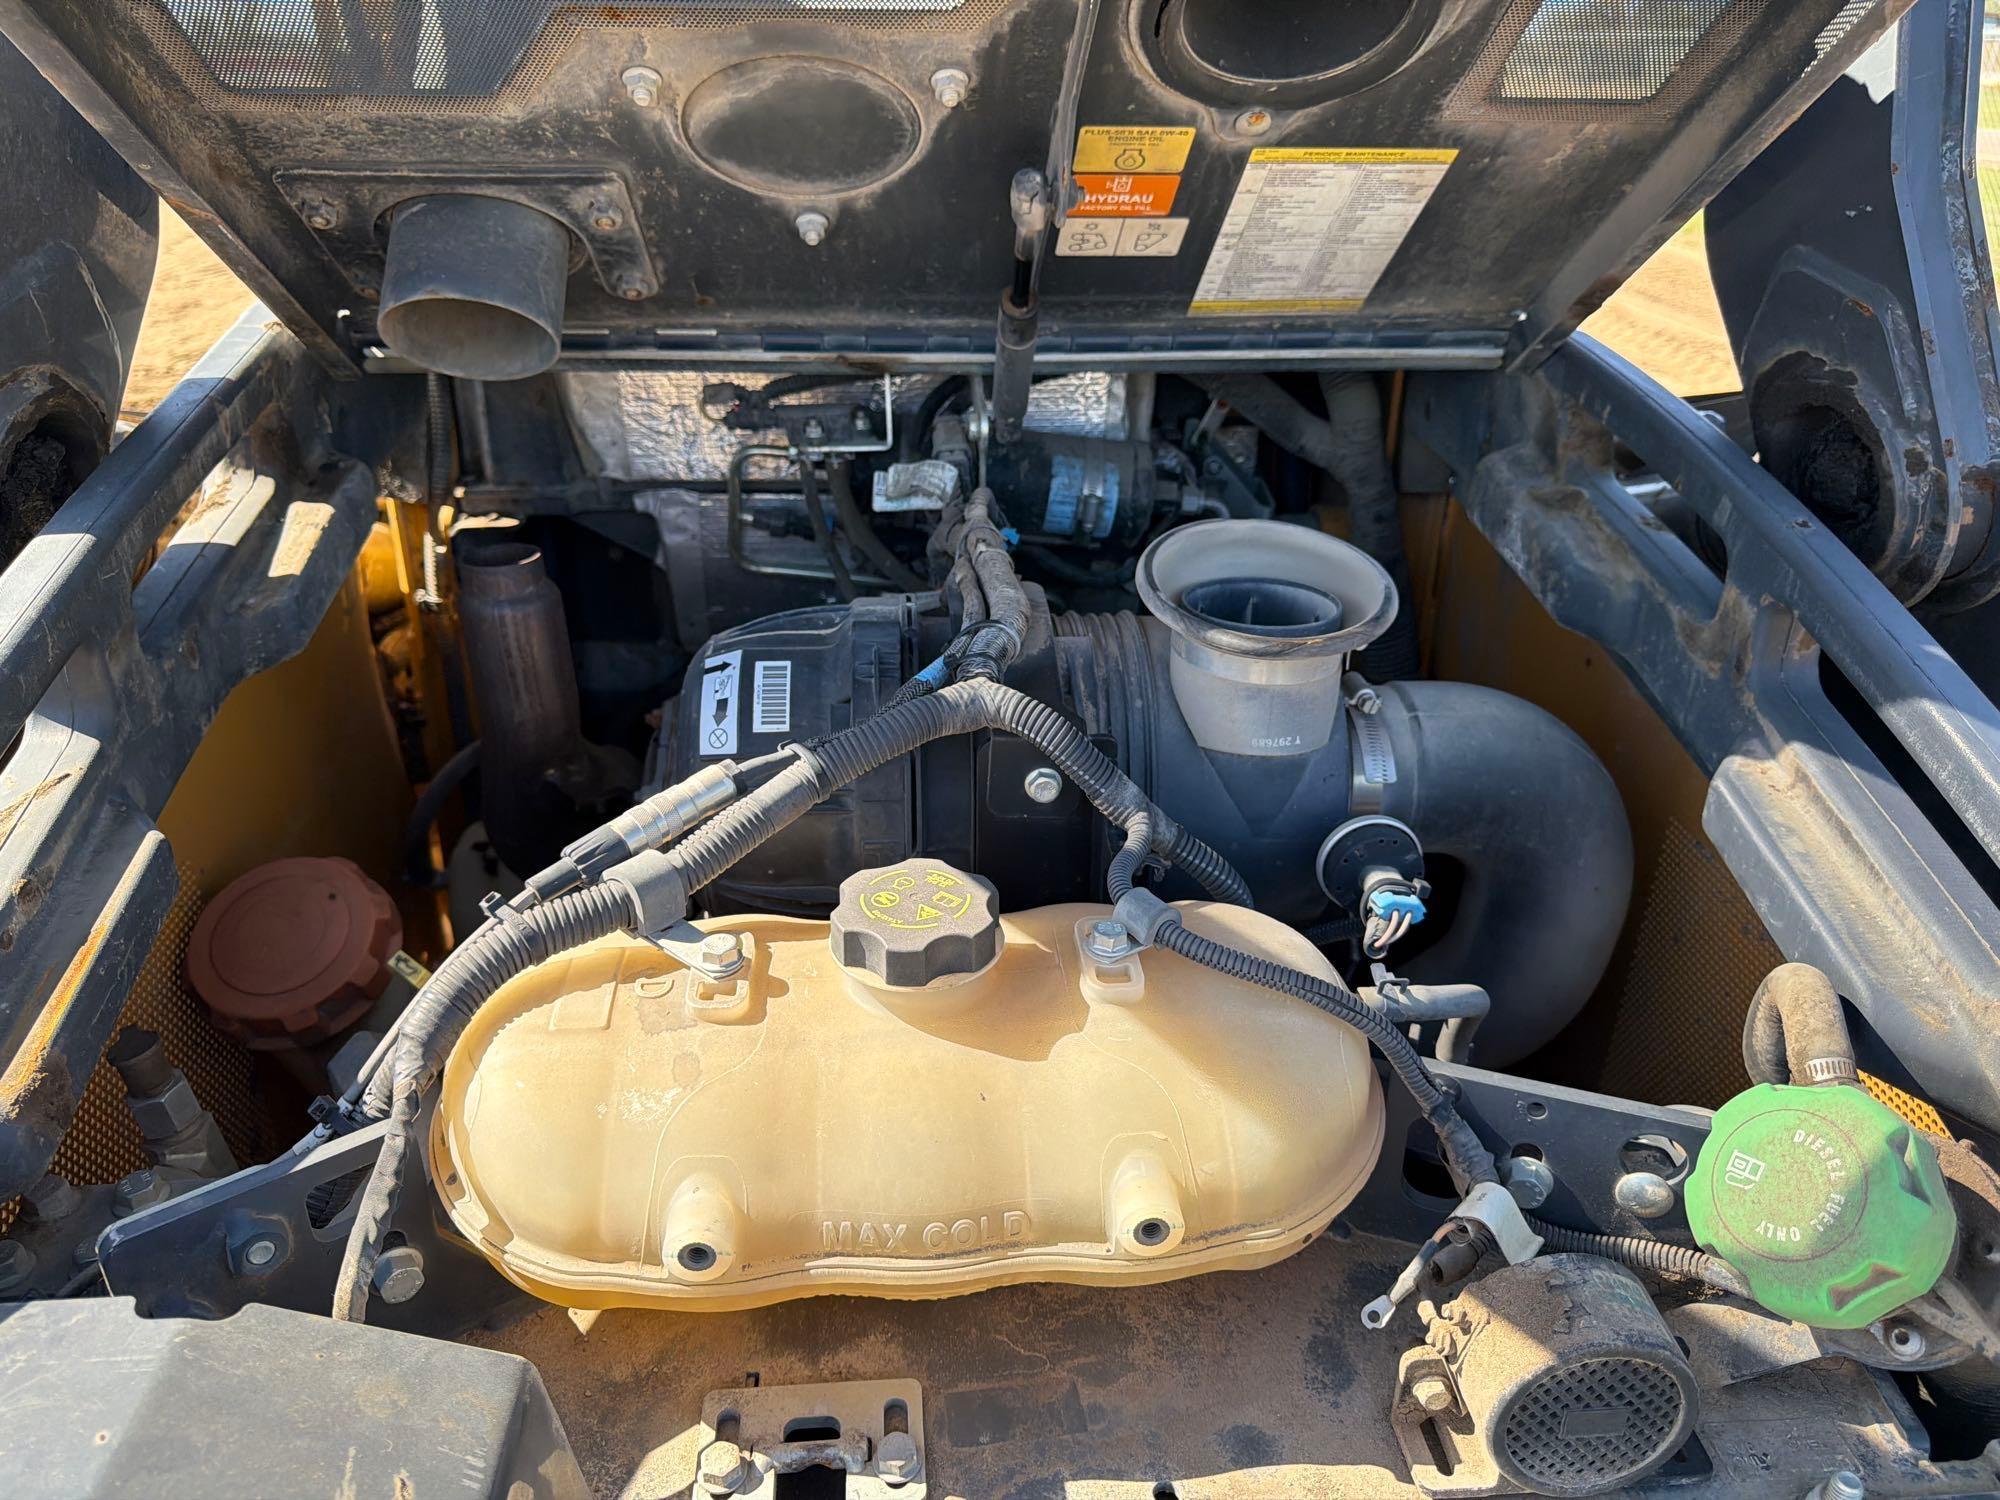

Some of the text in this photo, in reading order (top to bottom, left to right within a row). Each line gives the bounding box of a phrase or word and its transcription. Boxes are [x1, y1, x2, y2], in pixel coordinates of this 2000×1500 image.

[1084, 194, 1154, 203] HYDRAU
[1792, 1129, 1847, 1182] DIESEL
[822, 1210, 1032, 1251] MAX COLD
[1755, 1220, 1801, 1242] ONLY
[1809, 1192, 1845, 1232] FUEL
